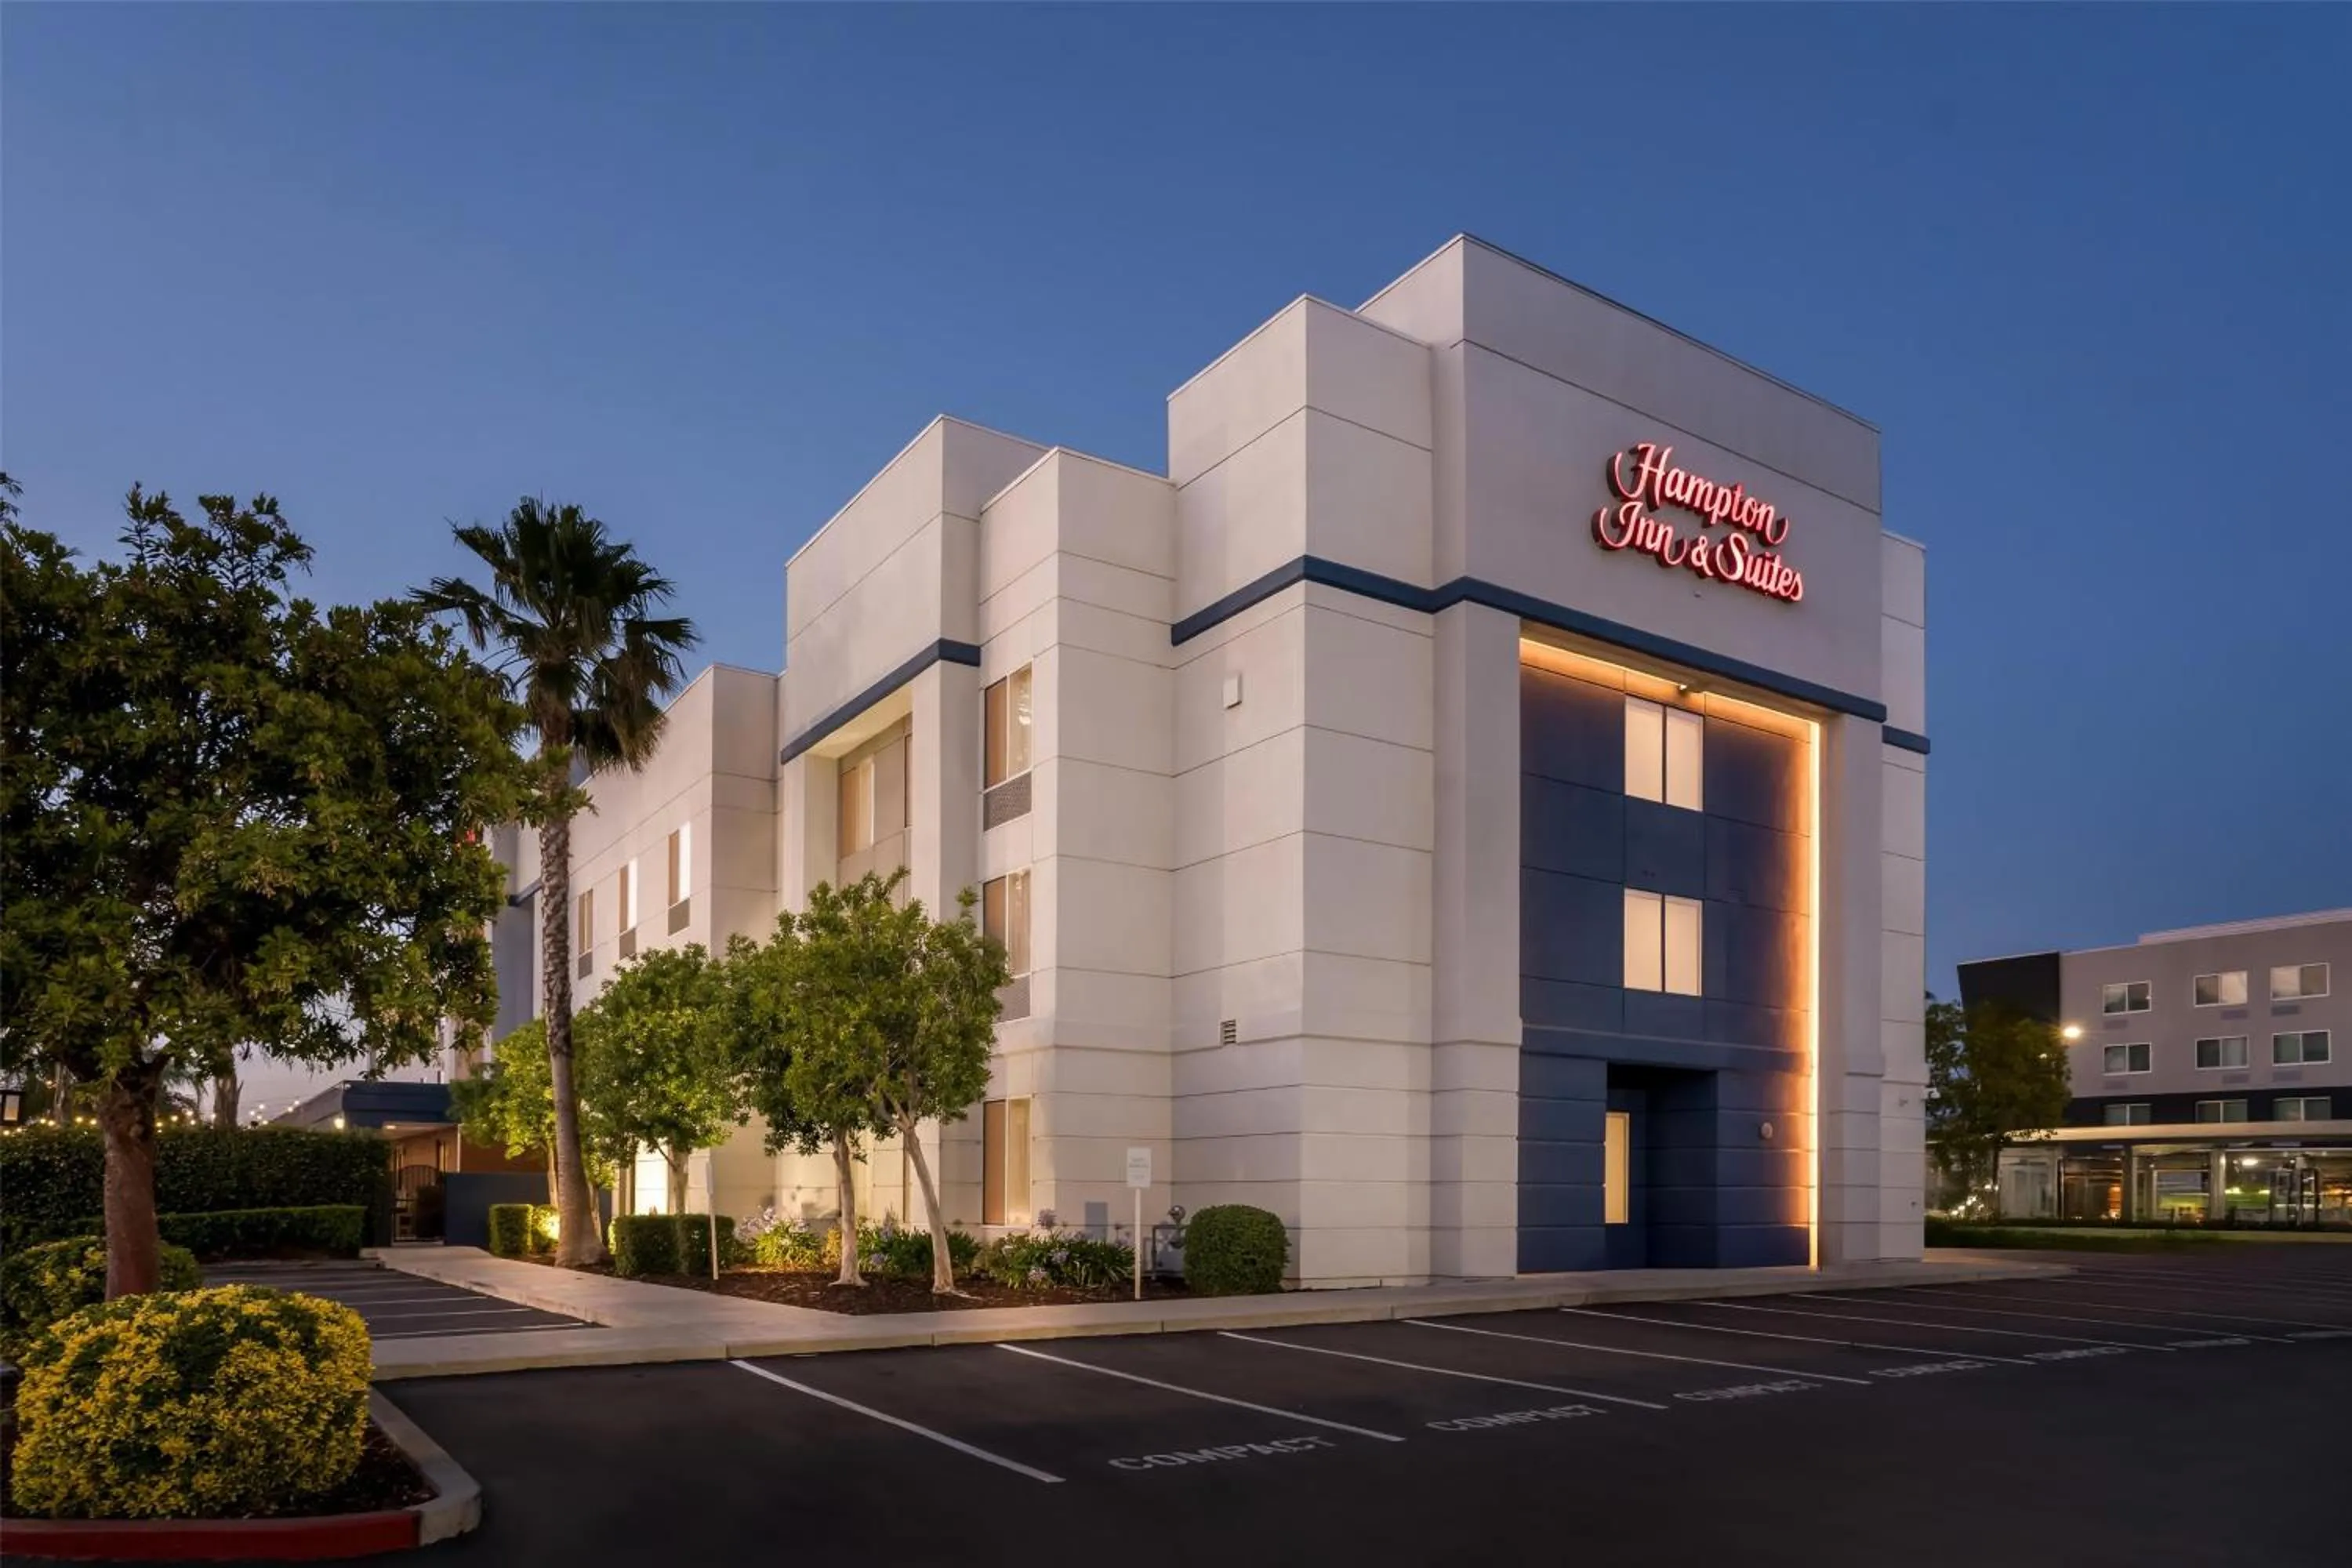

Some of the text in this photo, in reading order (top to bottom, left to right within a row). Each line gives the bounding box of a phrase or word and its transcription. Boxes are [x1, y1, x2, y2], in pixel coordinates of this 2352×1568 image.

[1608, 443, 1788, 545] Hampton
[1592, 501, 1803, 602] Inn & Suites
[1107, 1436, 1338, 1470] COMPACT
